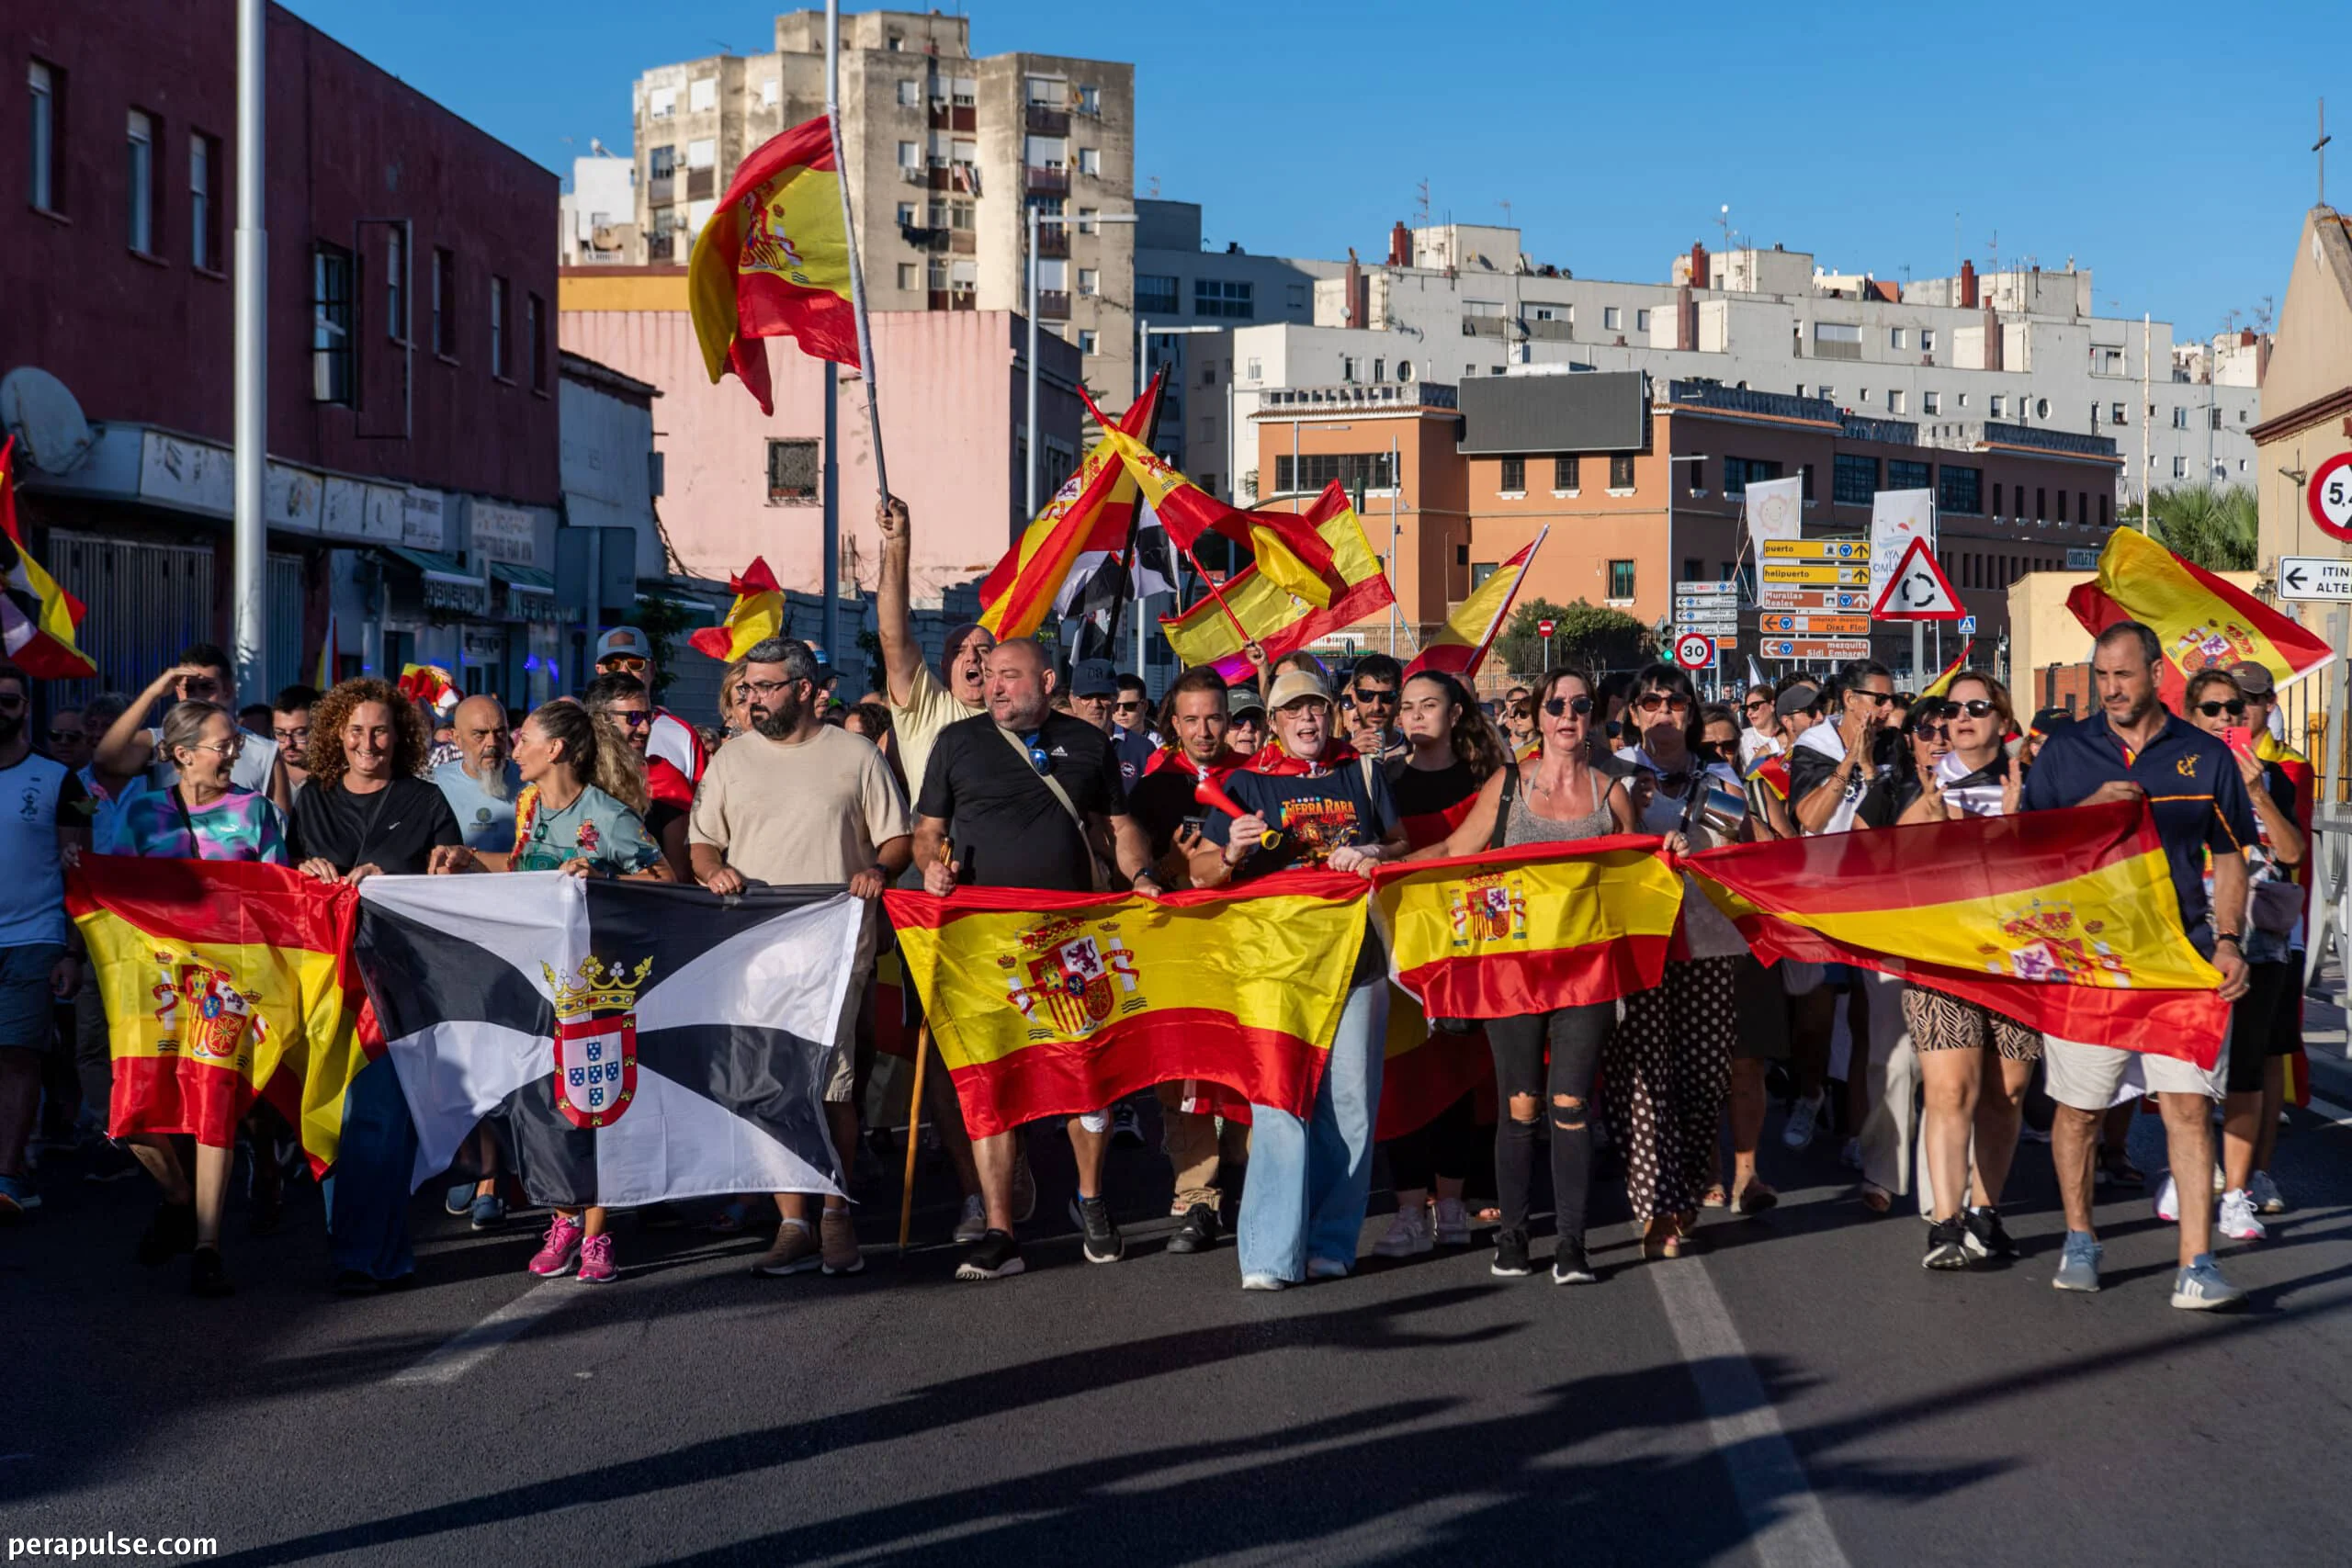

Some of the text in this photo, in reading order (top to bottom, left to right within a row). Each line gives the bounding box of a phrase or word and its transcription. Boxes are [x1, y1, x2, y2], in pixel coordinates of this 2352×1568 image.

[2329, 482, 2352, 507] 5.
[1765, 545, 1793, 554] puerto
[2068, 551, 2092, 566] OUTLET
[1765, 570, 1809, 579] helipuerto
[2323, 567, 2352, 578] ITIN
[2316, 582, 2352, 593] ALTE
[1684, 646, 1704, 657] 30
[1807, 649, 1867, 658] Sidi Embarek
[1282, 797, 1355, 817] TIERRA RARA
